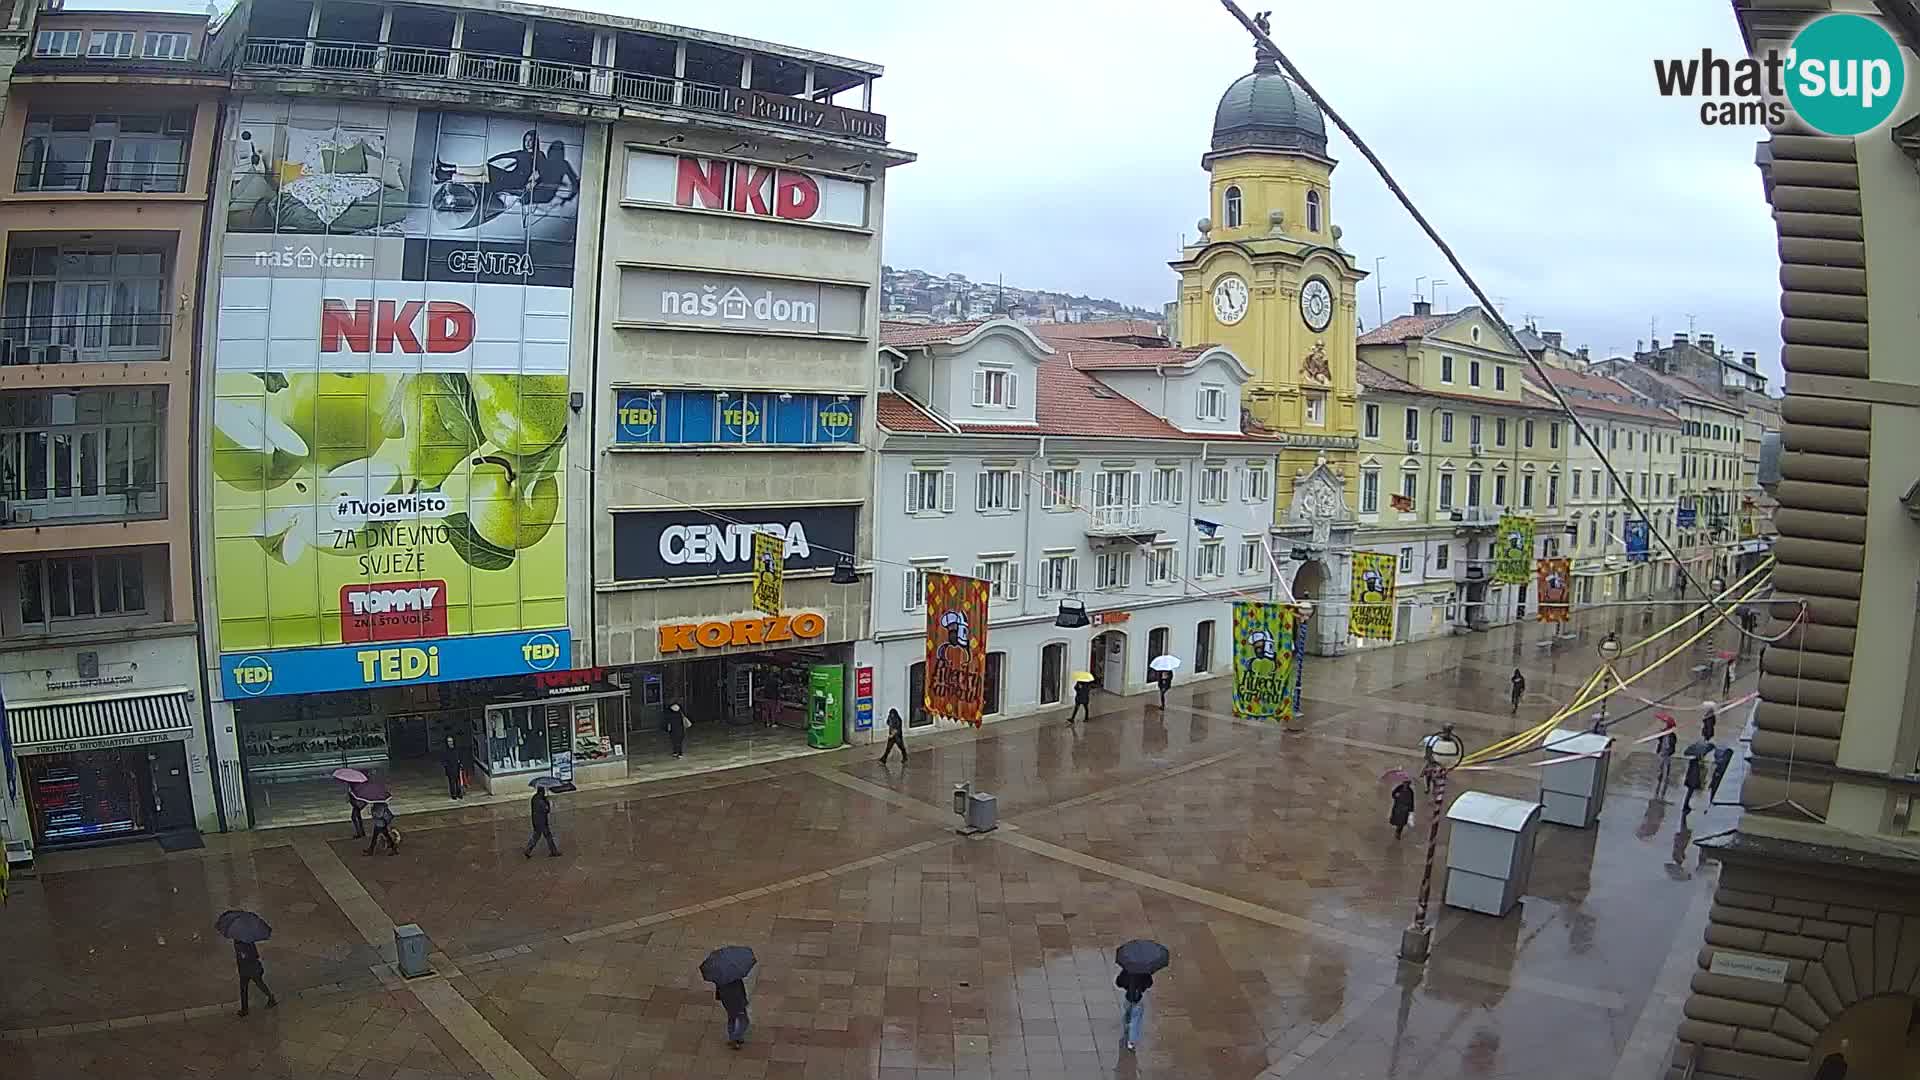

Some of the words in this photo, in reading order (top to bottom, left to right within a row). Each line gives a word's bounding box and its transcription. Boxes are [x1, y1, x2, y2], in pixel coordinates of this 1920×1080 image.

[723, 89, 745, 112] Le
[676, 157, 820, 220] NKD
[255, 246, 294, 269] naš
[319, 248, 365, 269] dom
[448, 250, 535, 276] CENTRA
[661, 284, 718, 317] naš
[754, 290, 816, 323] dom
[320, 298, 477, 354] NKD
[619, 408, 657, 425] TEDi
[724, 408, 759, 426] TEDi
[819, 411, 853, 427] TEDi
[338, 497, 446, 516] #TvojeMisto
[333, 529, 357, 549] ZA
[366, 525, 450, 549] DNEVNO
[359, 548, 426, 575] SVJEŽE
[348, 587, 440, 615] TOMMY
[659, 613, 826, 653] KORZO
[522, 643, 560, 661] TEDi
[233, 666, 273, 684] TEDi
[358, 646, 439, 683] TEDi
[47, 680, 78, 691] TOURIST
[80, 675, 134, 687] INFORMATION
[549, 685, 591, 695] MAXIMARKET
[80, 737, 134, 750] INFORMATIVNI
[137, 734, 168, 744] CENTAR
